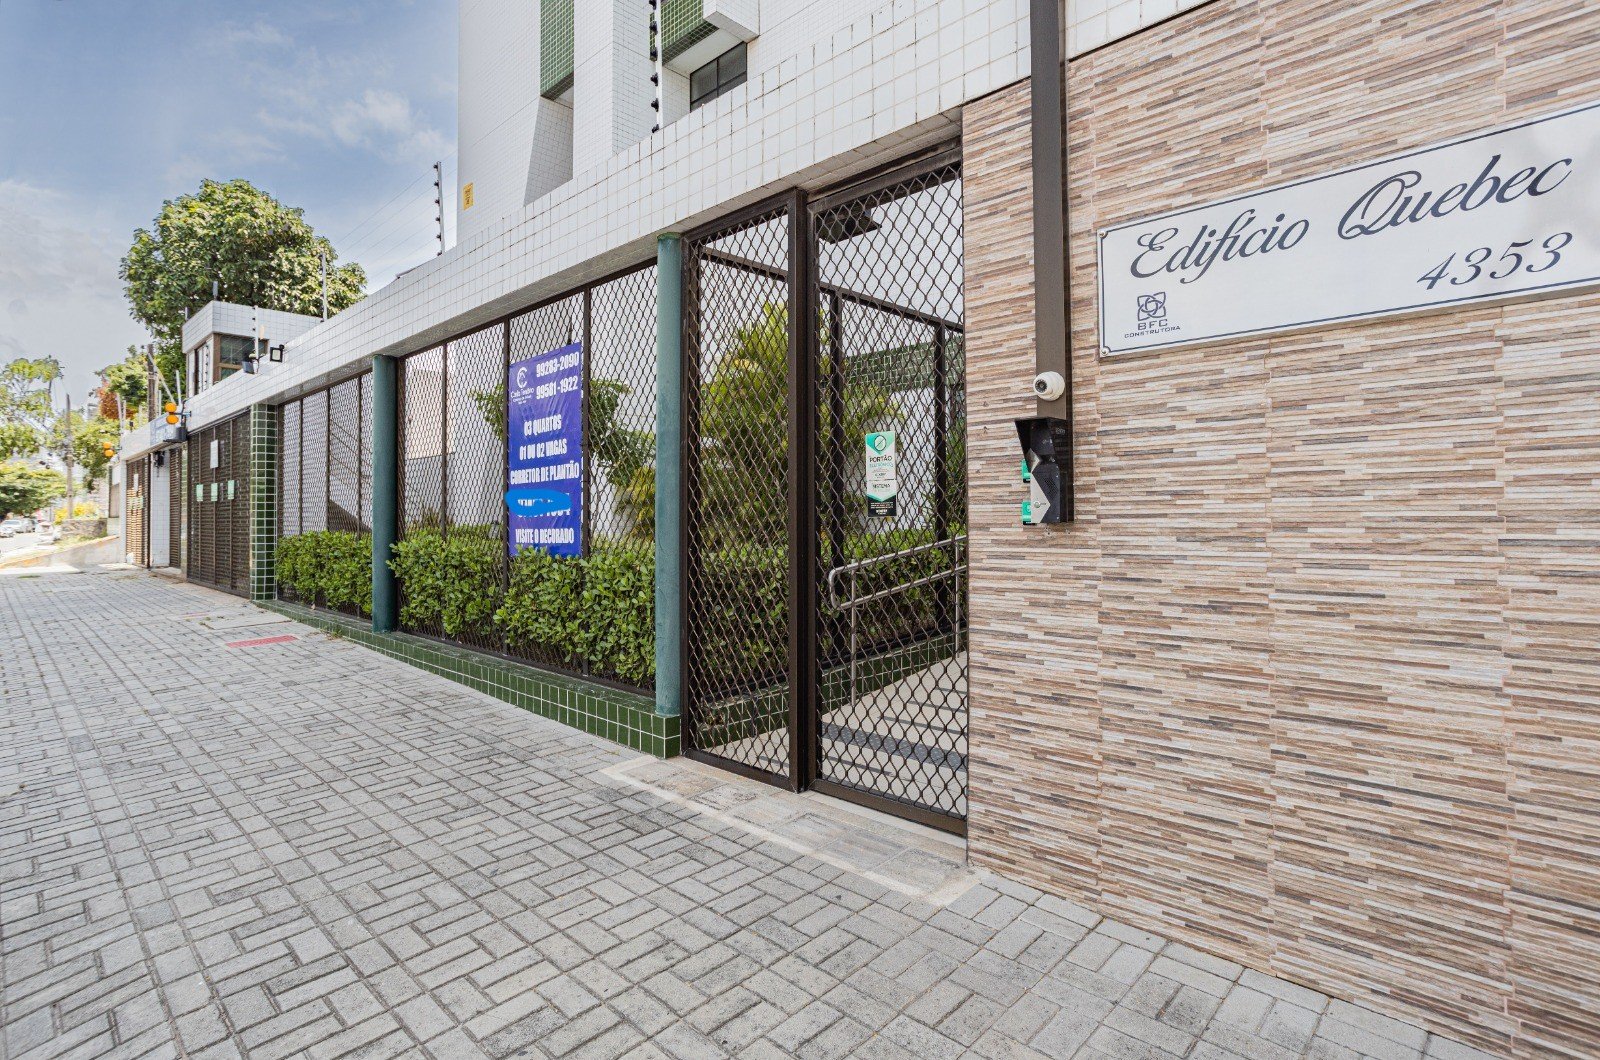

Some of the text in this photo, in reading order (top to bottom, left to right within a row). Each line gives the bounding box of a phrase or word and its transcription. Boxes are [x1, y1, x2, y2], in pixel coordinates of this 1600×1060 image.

[1130, 153, 1573, 284] Edifício Quebec
[1416, 231, 1573, 290] 4353
[1124, 325, 1181, 338] CONSTRUTORA
[1137, 319, 1168, 331] BFC
[536, 351, 580, 378] 99283-2090
[536, 375, 578, 400] 99581-1922
[523, 413, 562, 436] 03 QUARTOS
[519, 445, 527, 461] 01
[536, 442, 545, 458] 02
[545, 437, 568, 457] VAGAS
[510, 460, 580, 485] CORRETOR DE PLANTÃO
[515, 527, 575, 544] VISITE O DECORADO
